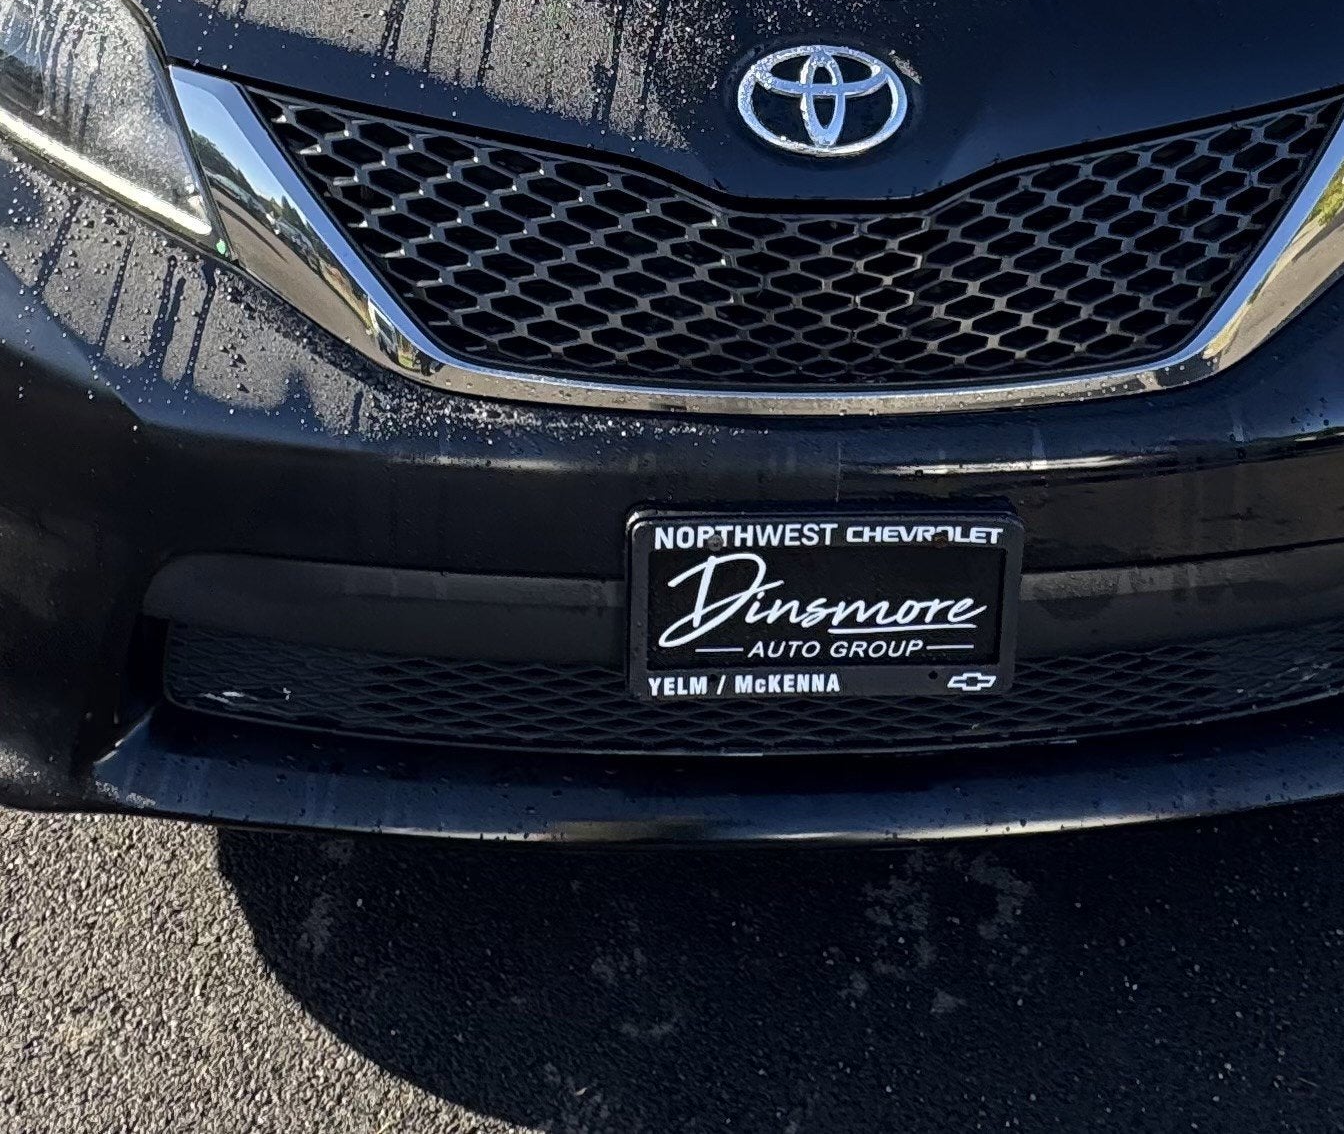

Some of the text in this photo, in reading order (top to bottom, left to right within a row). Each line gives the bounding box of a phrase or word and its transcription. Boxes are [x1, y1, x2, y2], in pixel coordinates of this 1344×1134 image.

[654, 523, 838, 550] NORTHWEST
[658, 552, 988, 648] Dinsmore
[747, 638, 924, 659] AUTO GROUP
[648, 676, 708, 697] YELM
[734, 673, 841, 694] McKENNA
